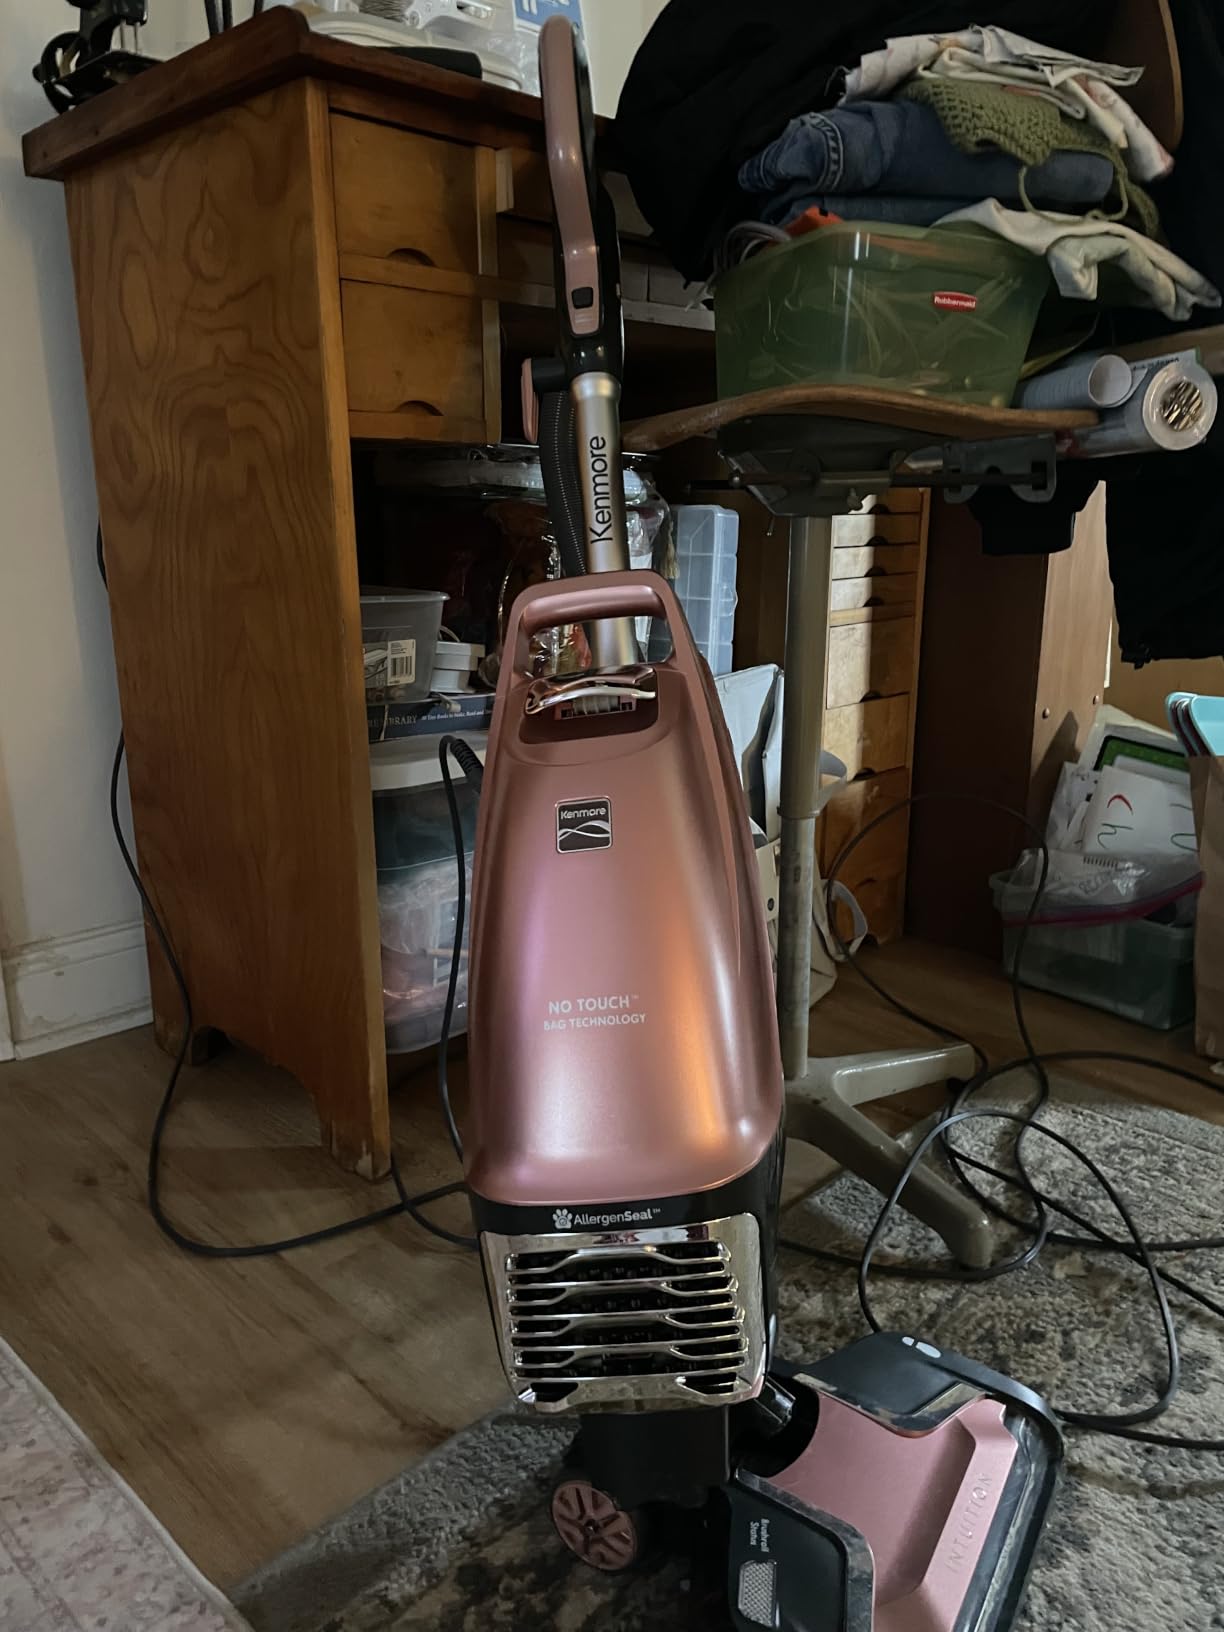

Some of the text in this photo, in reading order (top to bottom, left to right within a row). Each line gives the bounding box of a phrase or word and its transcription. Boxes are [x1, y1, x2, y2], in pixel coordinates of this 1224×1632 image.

[934, 295, 976, 308] Rubbermaid
[589, 435, 613, 544] Kenmore
[560, 807, 606, 820] Kenmore
[548, 1000, 572, 1015] NO
[543, 1014, 646, 1031] BAG TECHNOLOGY
[944, 1473, 992, 1574] INTUITION
